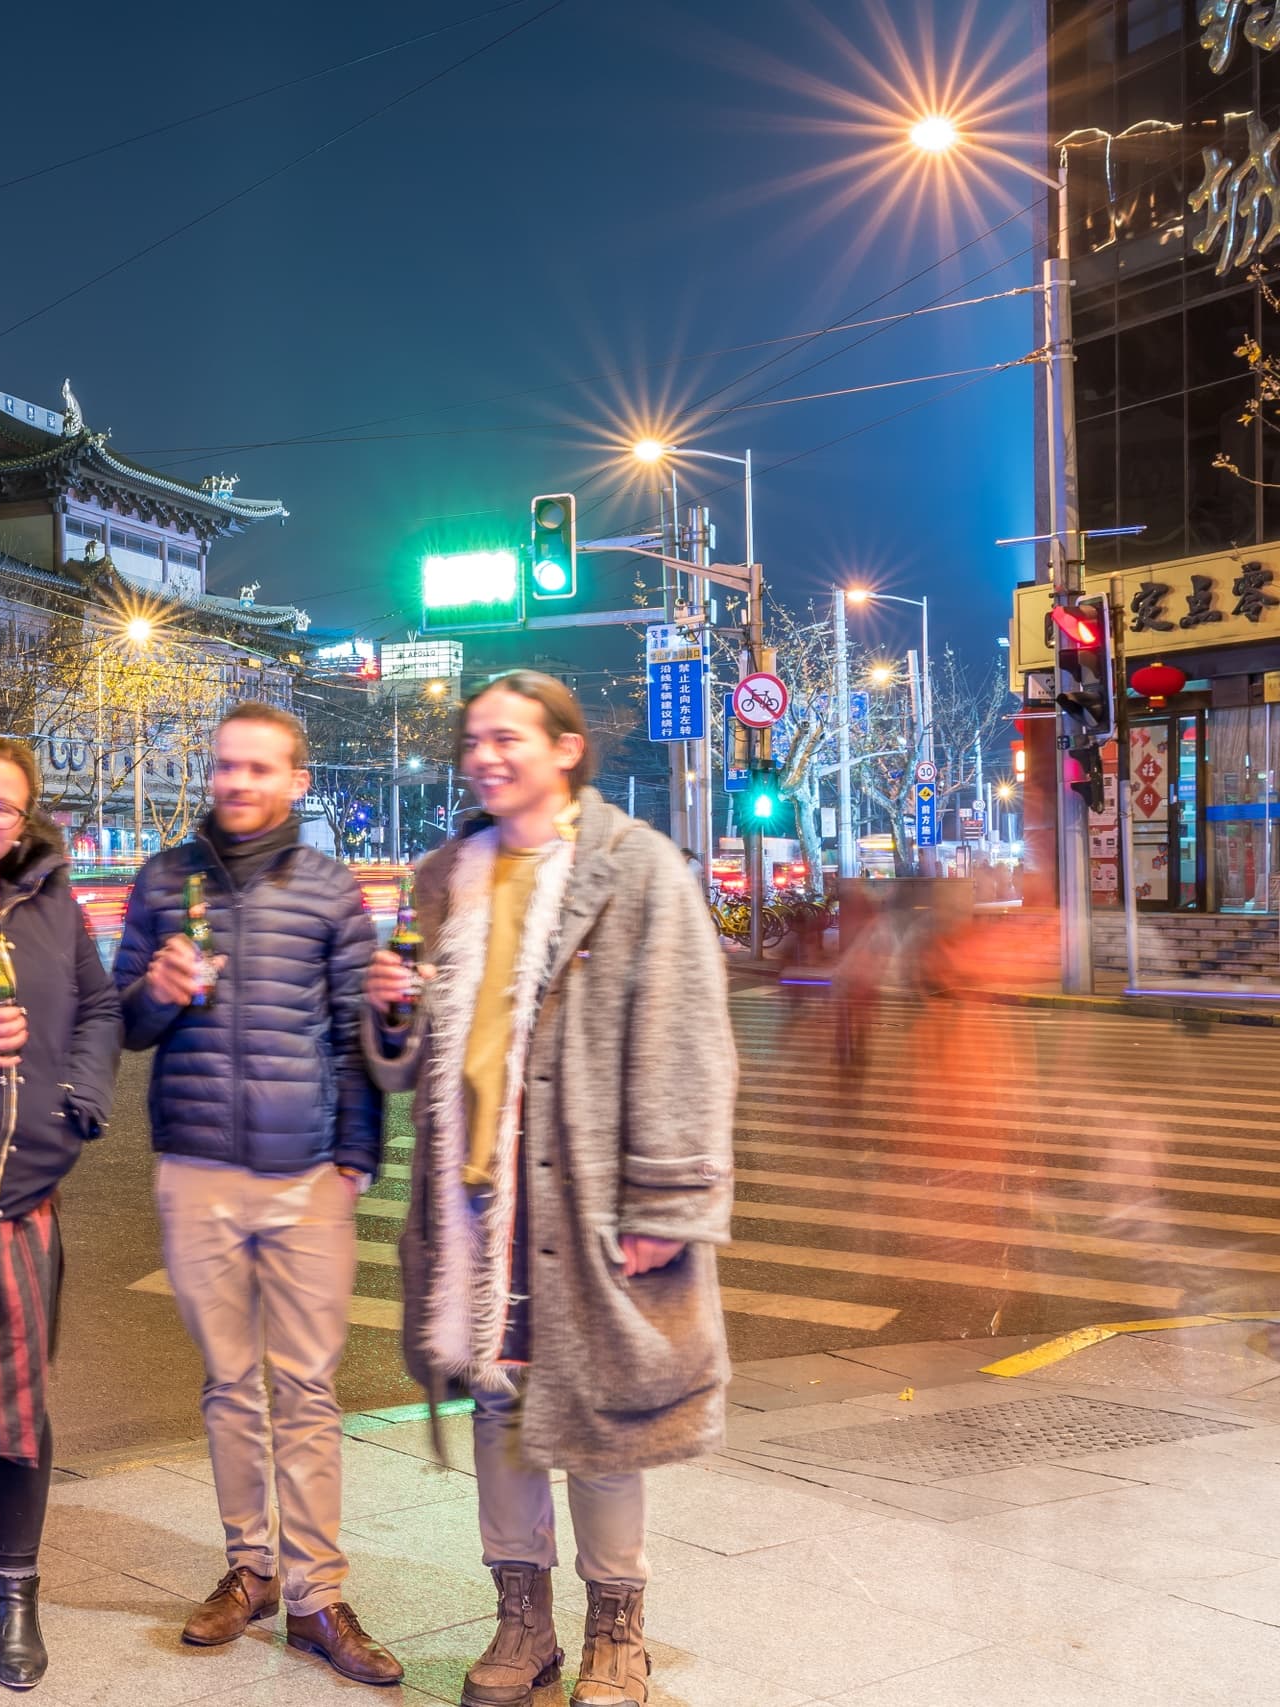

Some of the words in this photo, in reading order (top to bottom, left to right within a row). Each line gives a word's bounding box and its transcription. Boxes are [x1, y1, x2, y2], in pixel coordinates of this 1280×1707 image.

[660, 665, 673, 737] 沿线车辆建议绕行
[678, 663, 691, 735] 禁止北向东左转
[920, 767, 932, 777] 30
[921, 805, 932, 845] 前方施工
